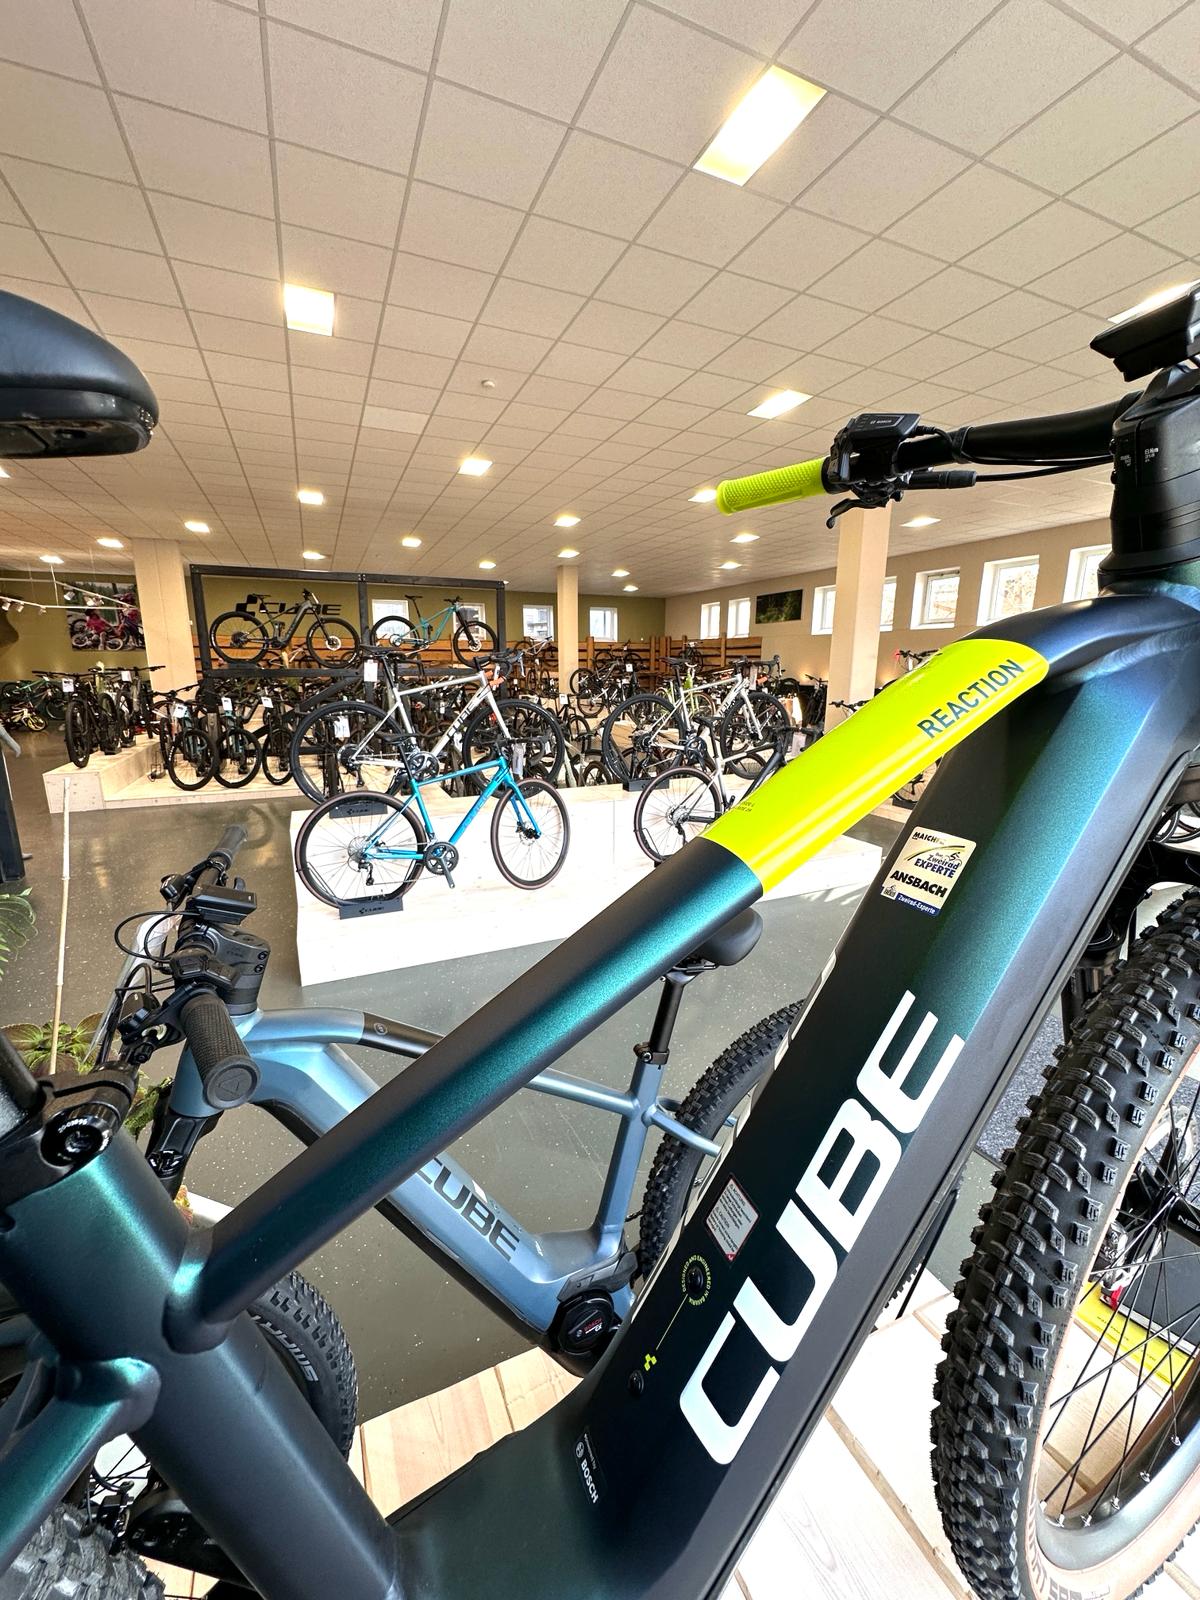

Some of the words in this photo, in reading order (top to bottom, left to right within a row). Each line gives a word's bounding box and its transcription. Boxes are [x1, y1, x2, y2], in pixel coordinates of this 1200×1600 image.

[916, 659, 1025, 739] REACTION
[914, 858, 956, 878] EXPERTE
[926, 854, 960, 870] Zweirad
[890, 870, 948, 898] ANSBACH
[680, 989, 966, 1465] CUBE
[580, 1458, 599, 1504] BOSCH
